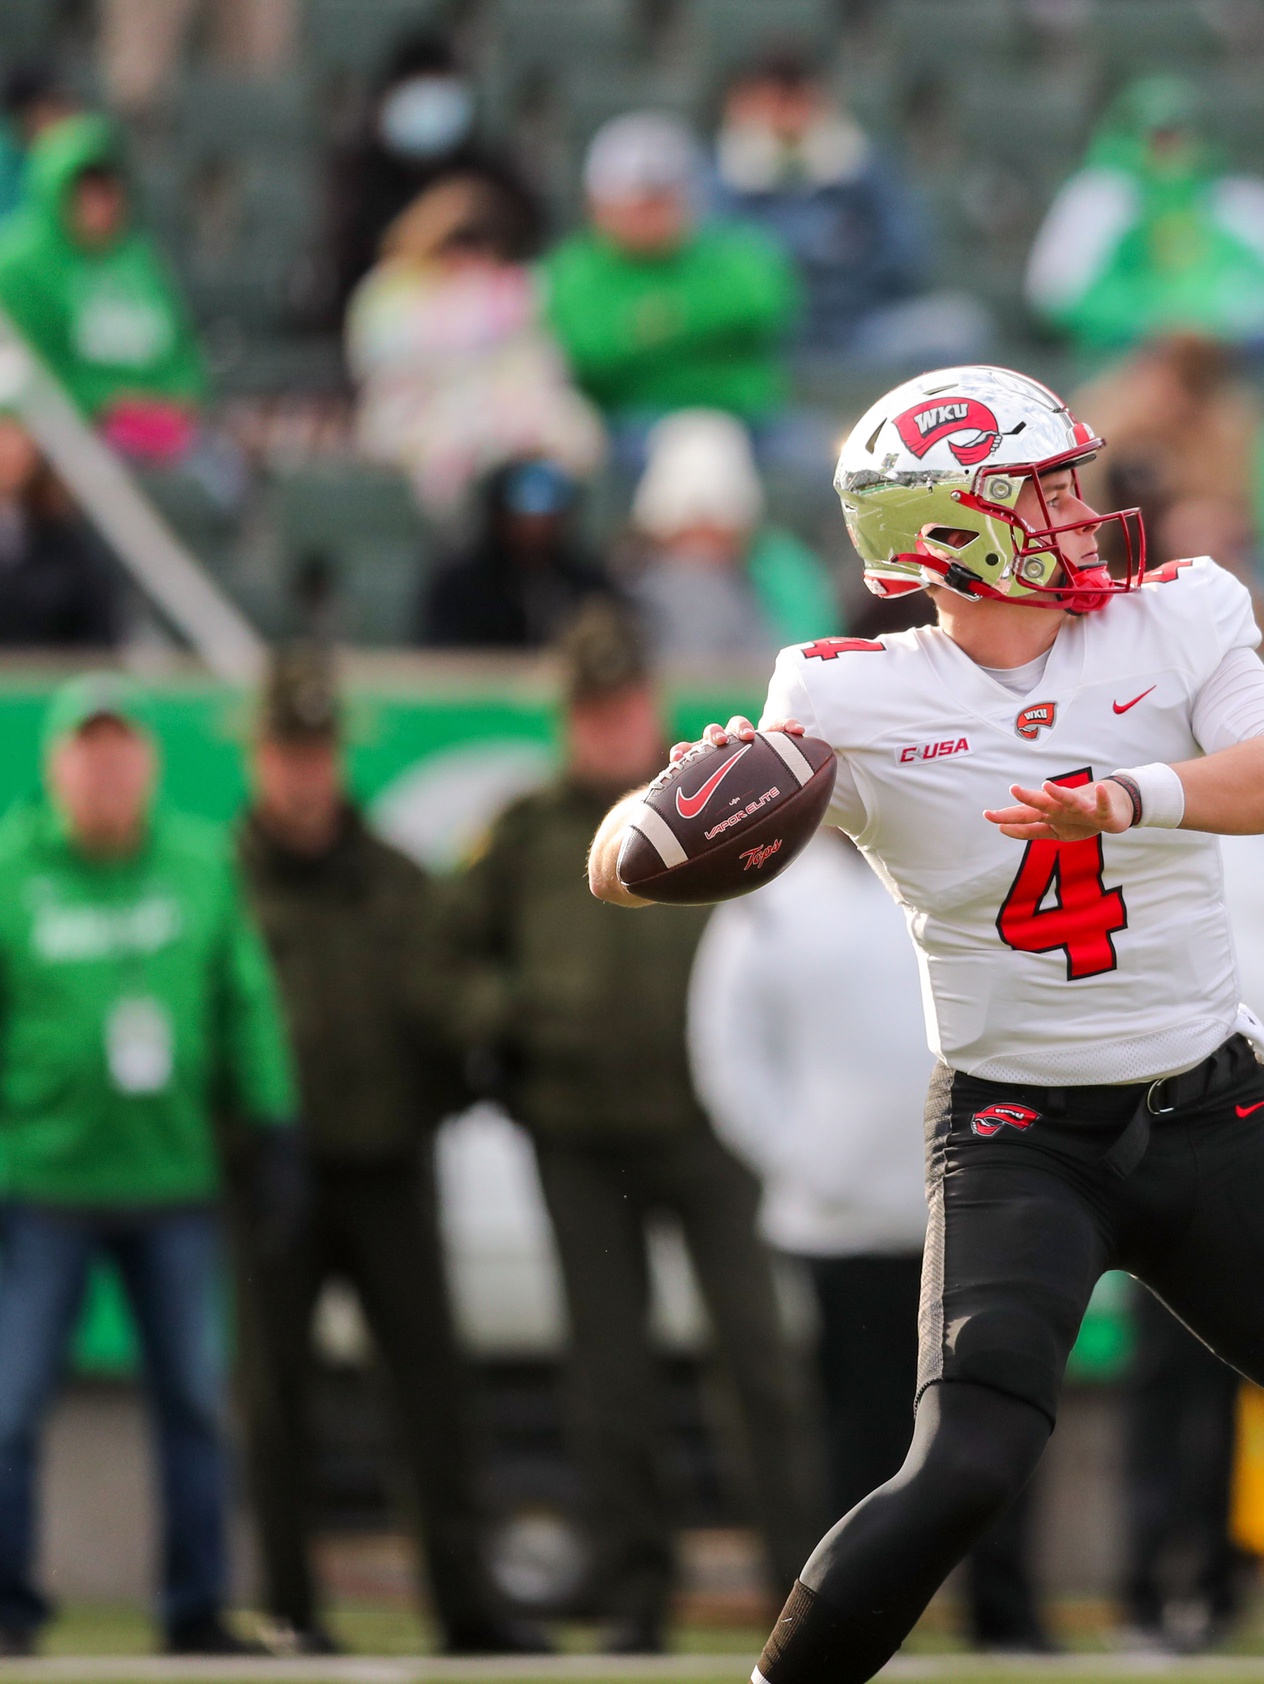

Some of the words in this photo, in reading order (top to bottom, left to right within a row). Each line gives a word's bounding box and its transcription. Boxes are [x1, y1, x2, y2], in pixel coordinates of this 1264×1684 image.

[913, 403, 968, 436] WKU
[801, 637, 886, 661] 4
[1024, 708, 1047, 721] WKU
[704, 810, 747, 839] VAPOR
[745, 786, 780, 814] ELITE
[739, 839, 782, 870] Tops
[996, 767, 1127, 980] 4
